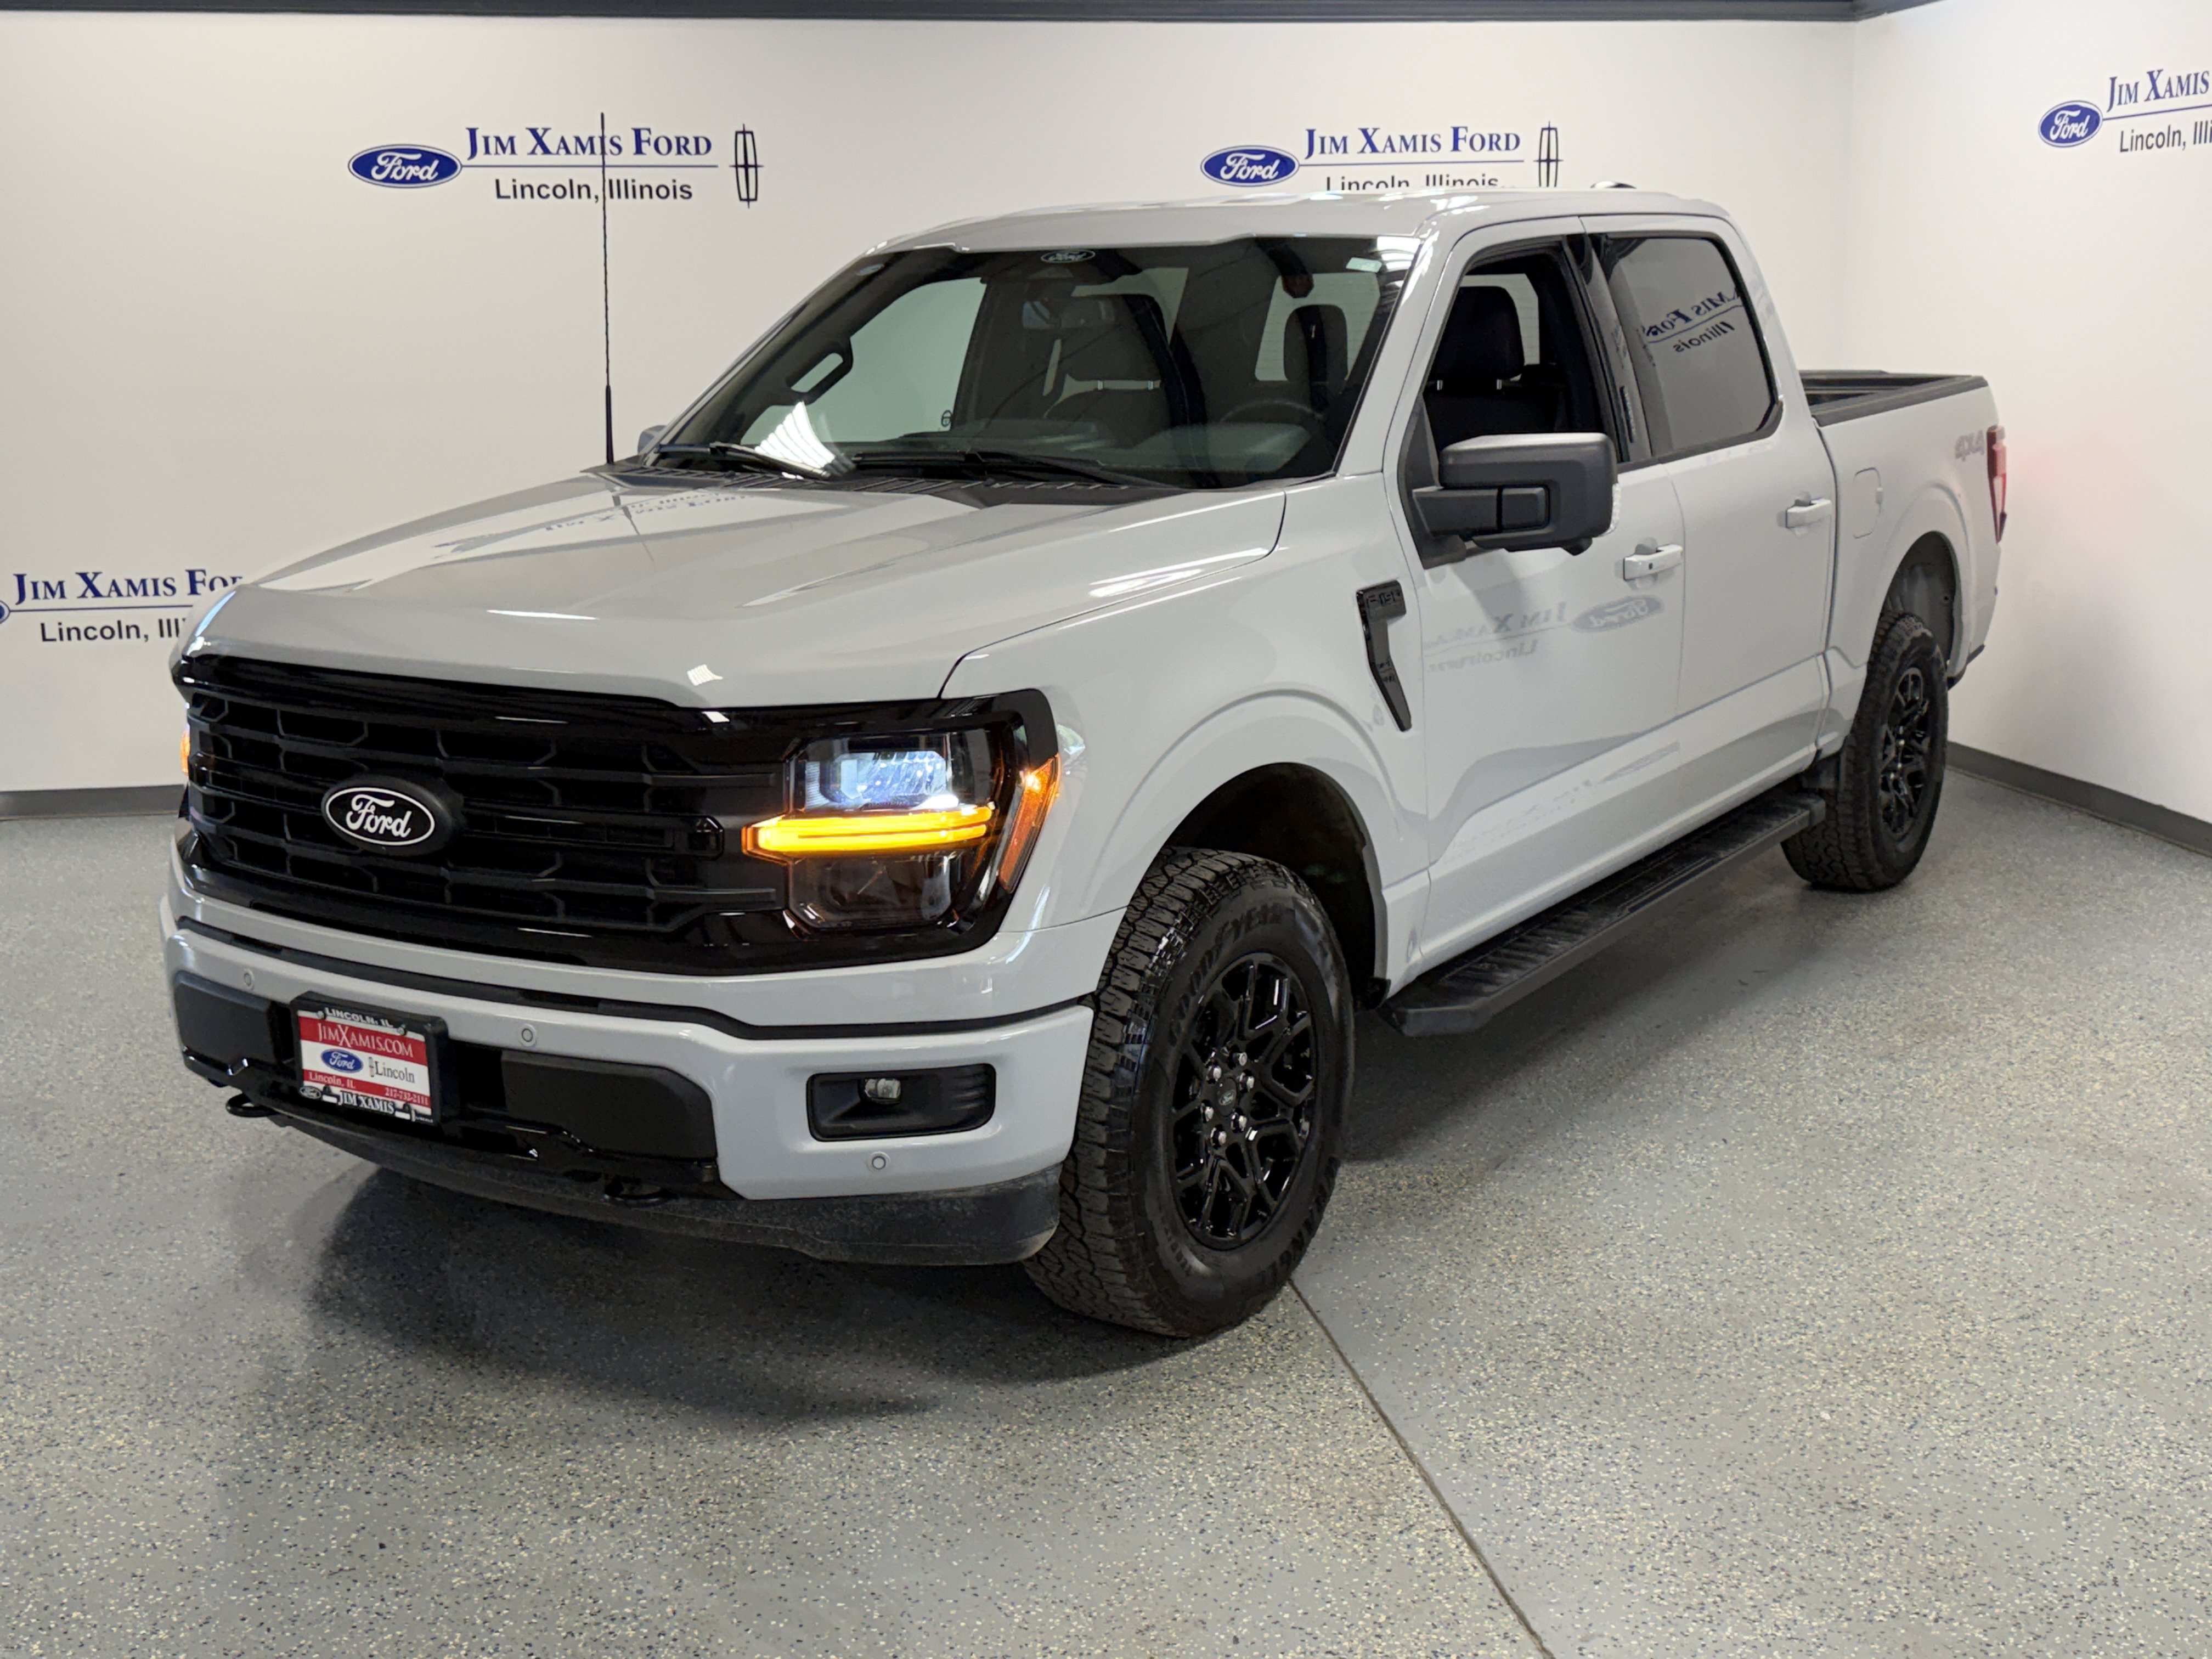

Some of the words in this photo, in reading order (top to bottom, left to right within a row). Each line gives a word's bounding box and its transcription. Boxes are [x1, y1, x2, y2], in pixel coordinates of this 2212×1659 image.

[2107, 76, 2140, 112] JIM
[2144, 69, 2210, 102] XAMIS
[2050, 109, 2091, 141] Ford
[2119, 125, 2186, 153] Lincoln,
[2193, 120, 2212, 145] Illi
[465, 127, 518, 160] JIM
[525, 127, 623, 156] XAMIS
[631, 127, 712, 156] FORD
[1304, 128, 1348, 160] JIM
[1357, 127, 1442, 154] XAMIS
[1450, 126, 1521, 153] FORD
[371, 152, 439, 183] Ford
[1220, 152, 1279, 180] Ford
[495, 178, 600, 203] Lincoln,
[608, 179, 693, 200] Illinois
[1327, 175, 1410, 191] Lincoln
[13, 573, 67, 605] JIM
[76, 571, 177, 599] XAMIS
[185, 569, 242, 596] FO
[41, 619, 149, 642] Lincoln,
[346, 794, 412, 838] Ford
[329, 1051, 356, 1070] Ford
[375, 1061, 415, 1084] Lincoln
[338, 1090, 358, 1105] JIM
[360, 1096, 394, 1114] XAMIS
